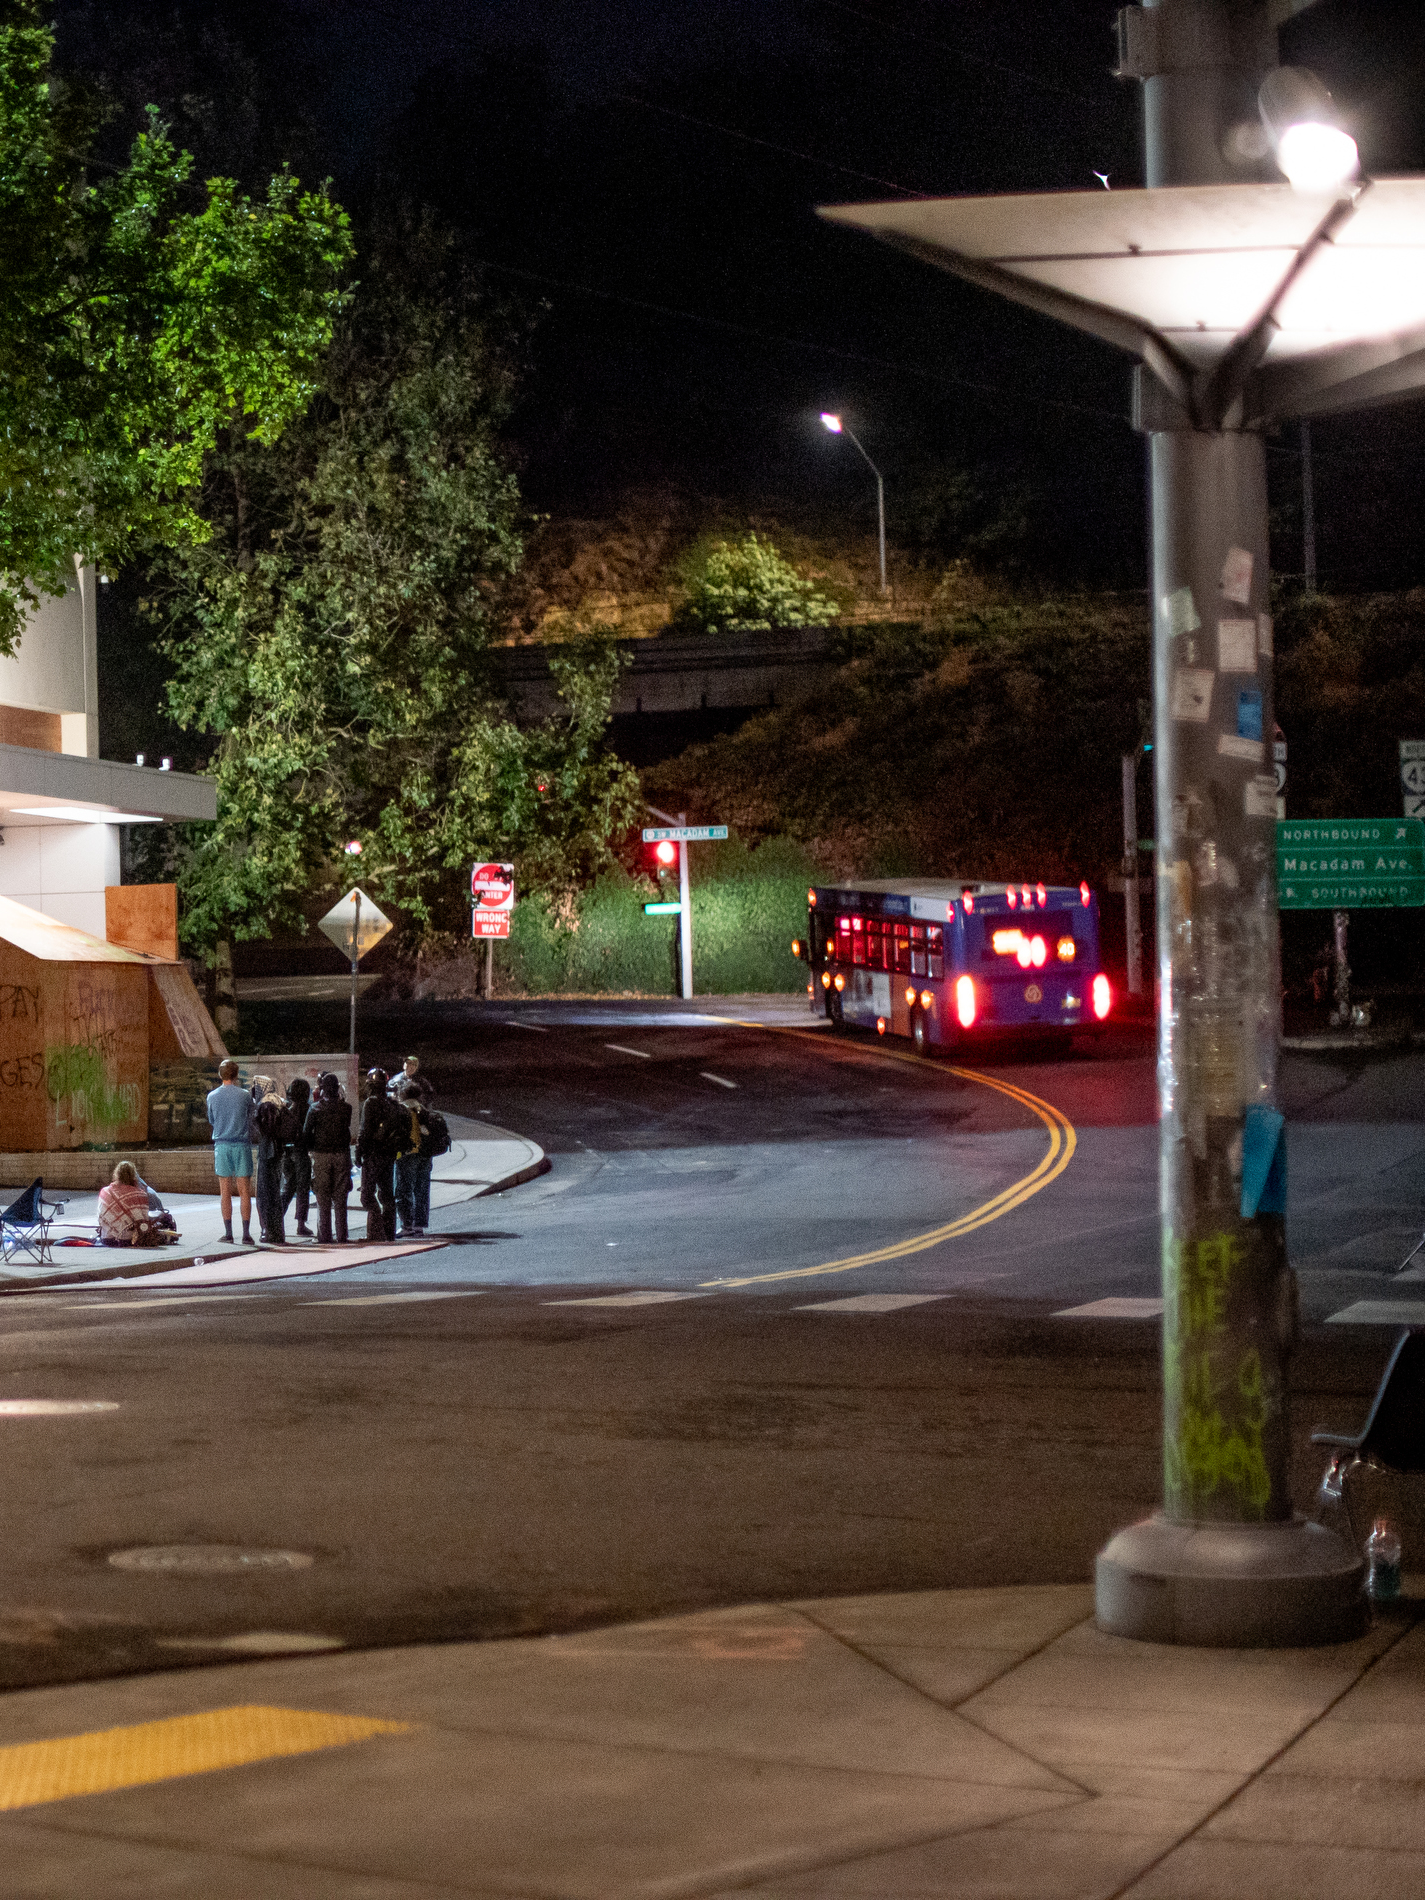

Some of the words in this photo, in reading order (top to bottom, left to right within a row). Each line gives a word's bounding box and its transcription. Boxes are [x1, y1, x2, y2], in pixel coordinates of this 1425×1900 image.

[670, 827, 709, 838] MACADAM
[1283, 828, 1380, 840] NORTHBOUND
[1283, 858, 1365, 872] Macadam
[1374, 855, 1413, 871] Ave.
[479, 872, 489, 881] DO
[482, 891, 503, 899] NTER
[481, 924, 501, 934] WAY
[1059, 942, 1075, 956] 40
